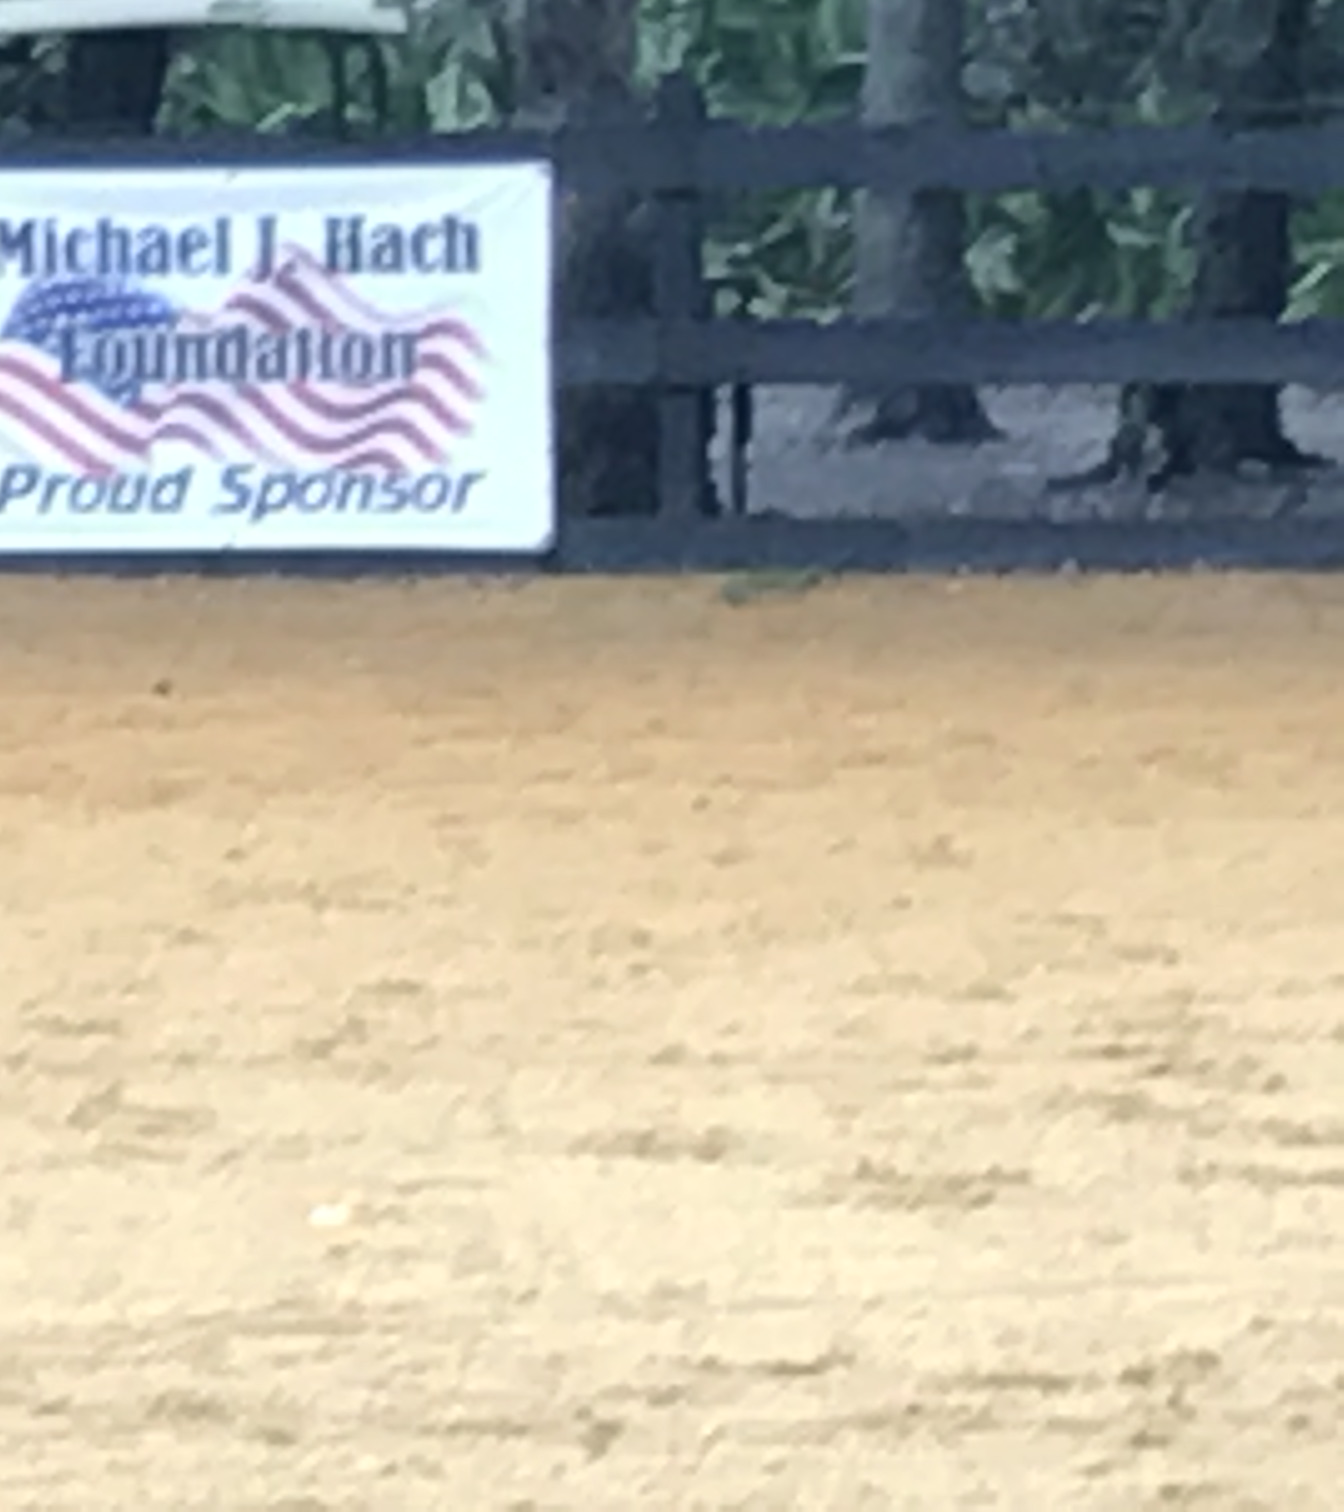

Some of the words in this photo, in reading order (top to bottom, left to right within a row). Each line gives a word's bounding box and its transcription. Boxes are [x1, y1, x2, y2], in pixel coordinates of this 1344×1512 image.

[325, 213, 482, 274] Hach
[60, 326, 418, 382] Foundation
[211, 463, 486, 524] Sponsor
